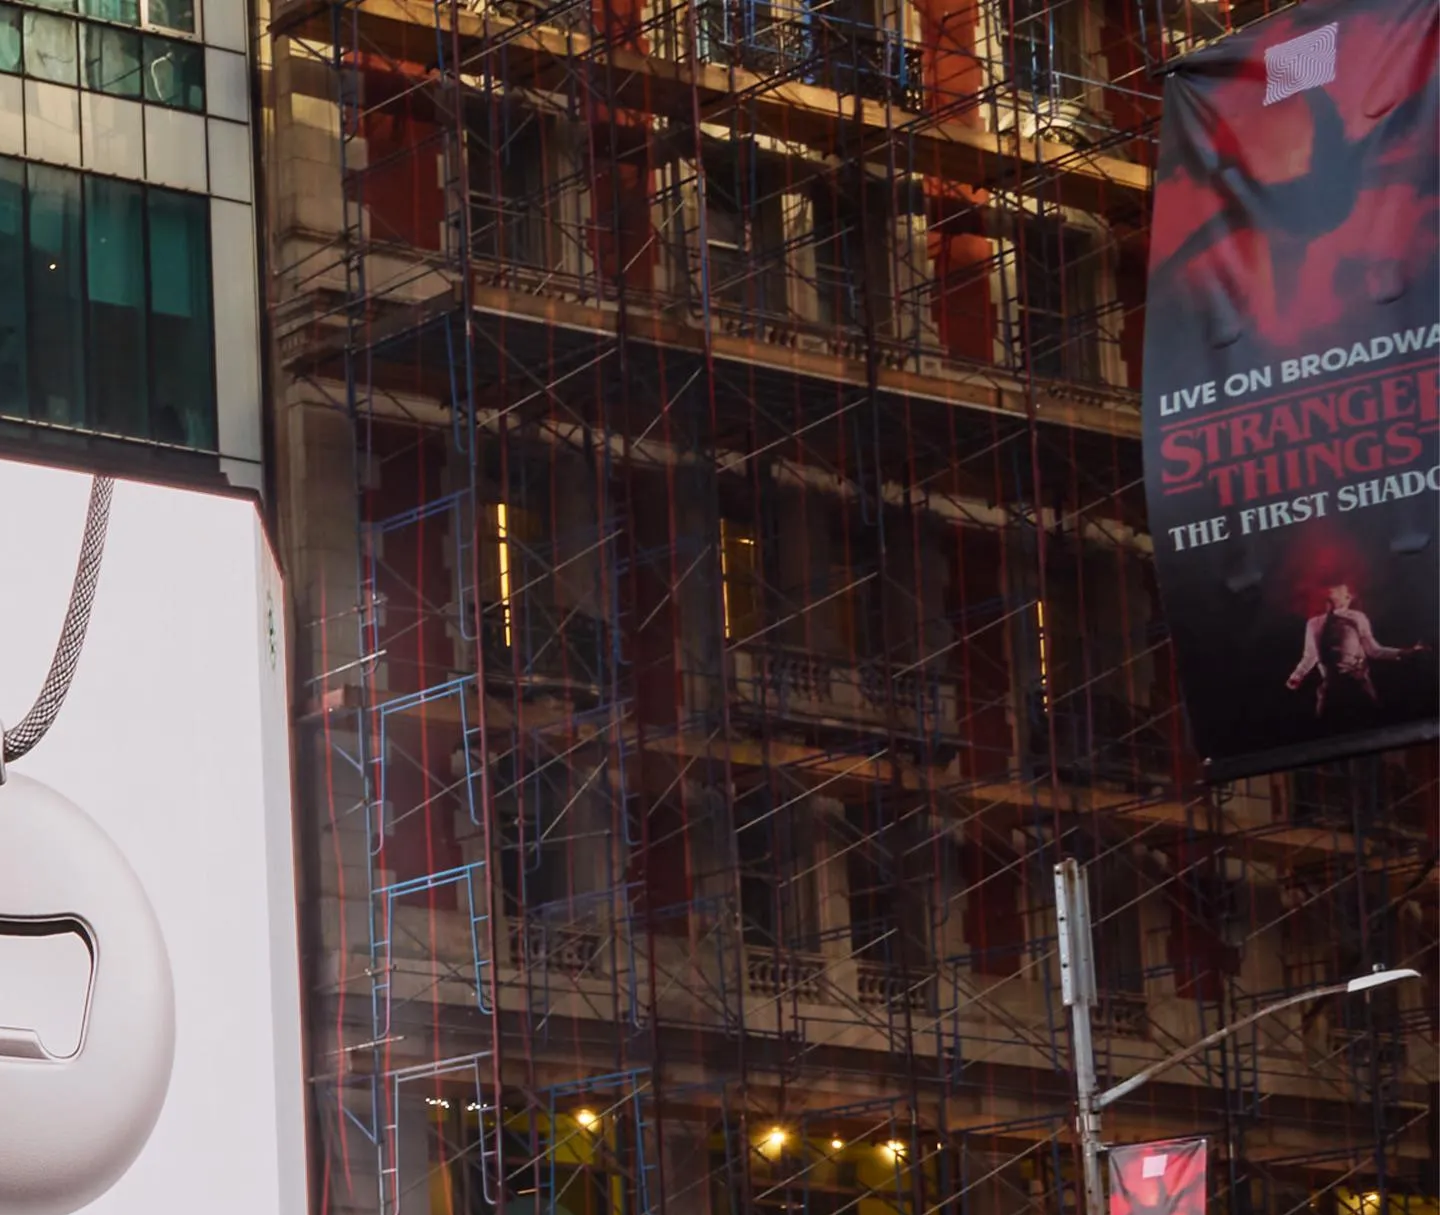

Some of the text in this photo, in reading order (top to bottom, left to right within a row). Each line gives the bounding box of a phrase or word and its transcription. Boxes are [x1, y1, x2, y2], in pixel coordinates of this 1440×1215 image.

[1160, 381, 1217, 417] LIVE
[1224, 366, 1272, 397] ON
[1209, 422, 1423, 508] THINGS
[1168, 516, 1231, 551] THE
[1239, 491, 1329, 535] FIRST
